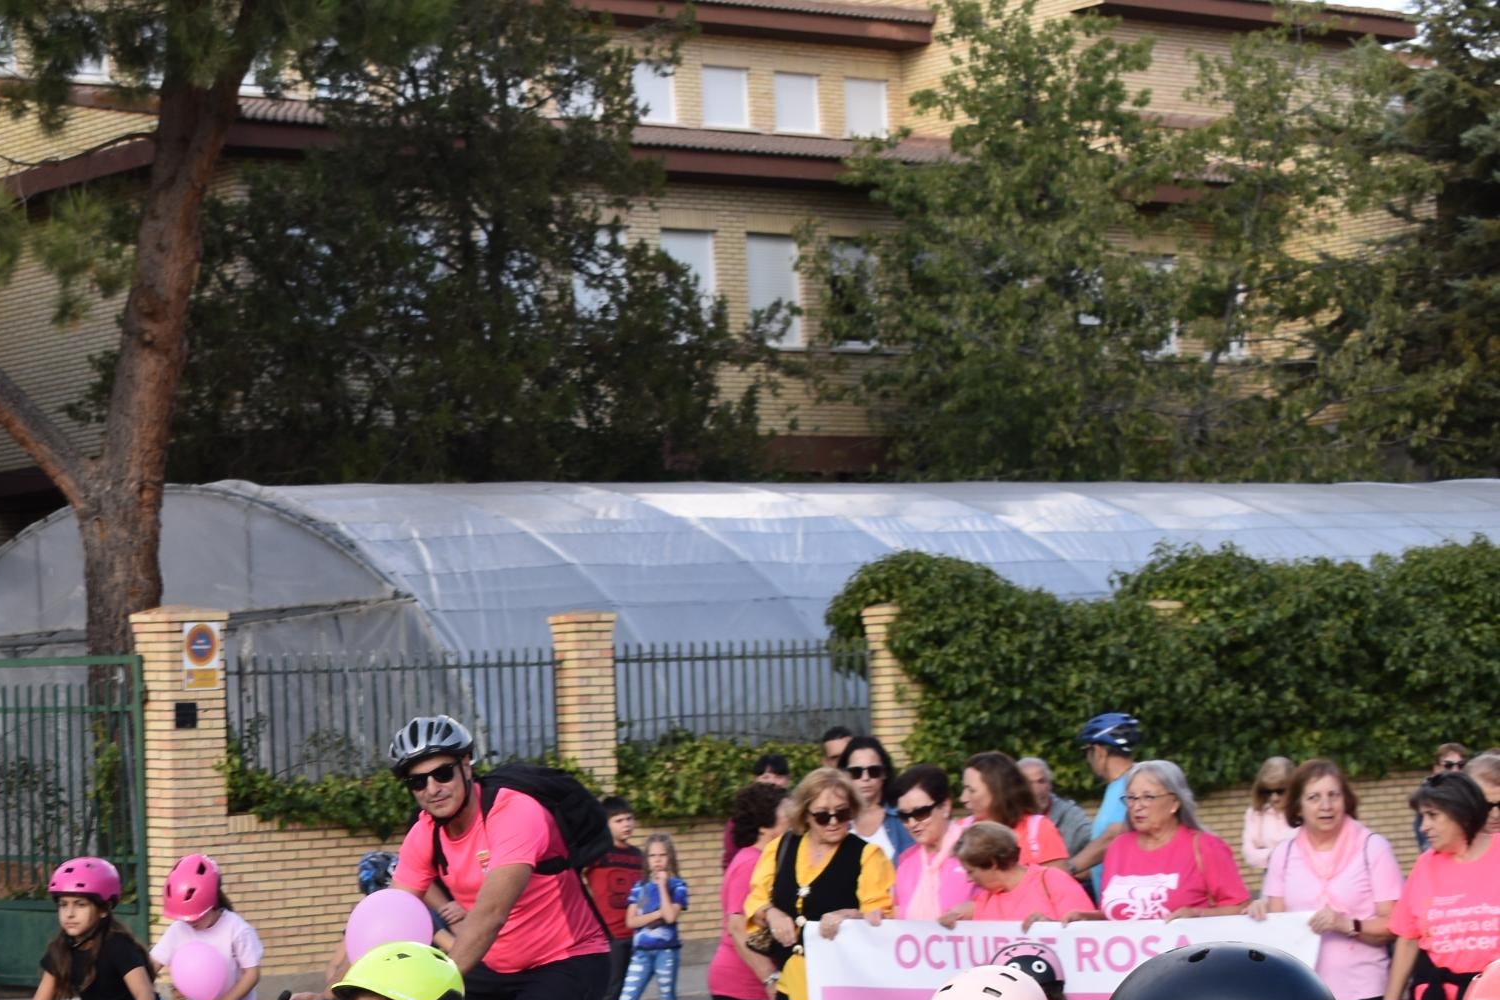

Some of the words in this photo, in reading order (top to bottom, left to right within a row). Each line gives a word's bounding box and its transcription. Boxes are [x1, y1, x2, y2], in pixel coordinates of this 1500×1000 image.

[1429, 921, 1479, 936] contra
[1481, 917, 1499, 932] el
[895, 934, 1057, 970] OCTU
[1431, 935, 1499, 953] cáncer
